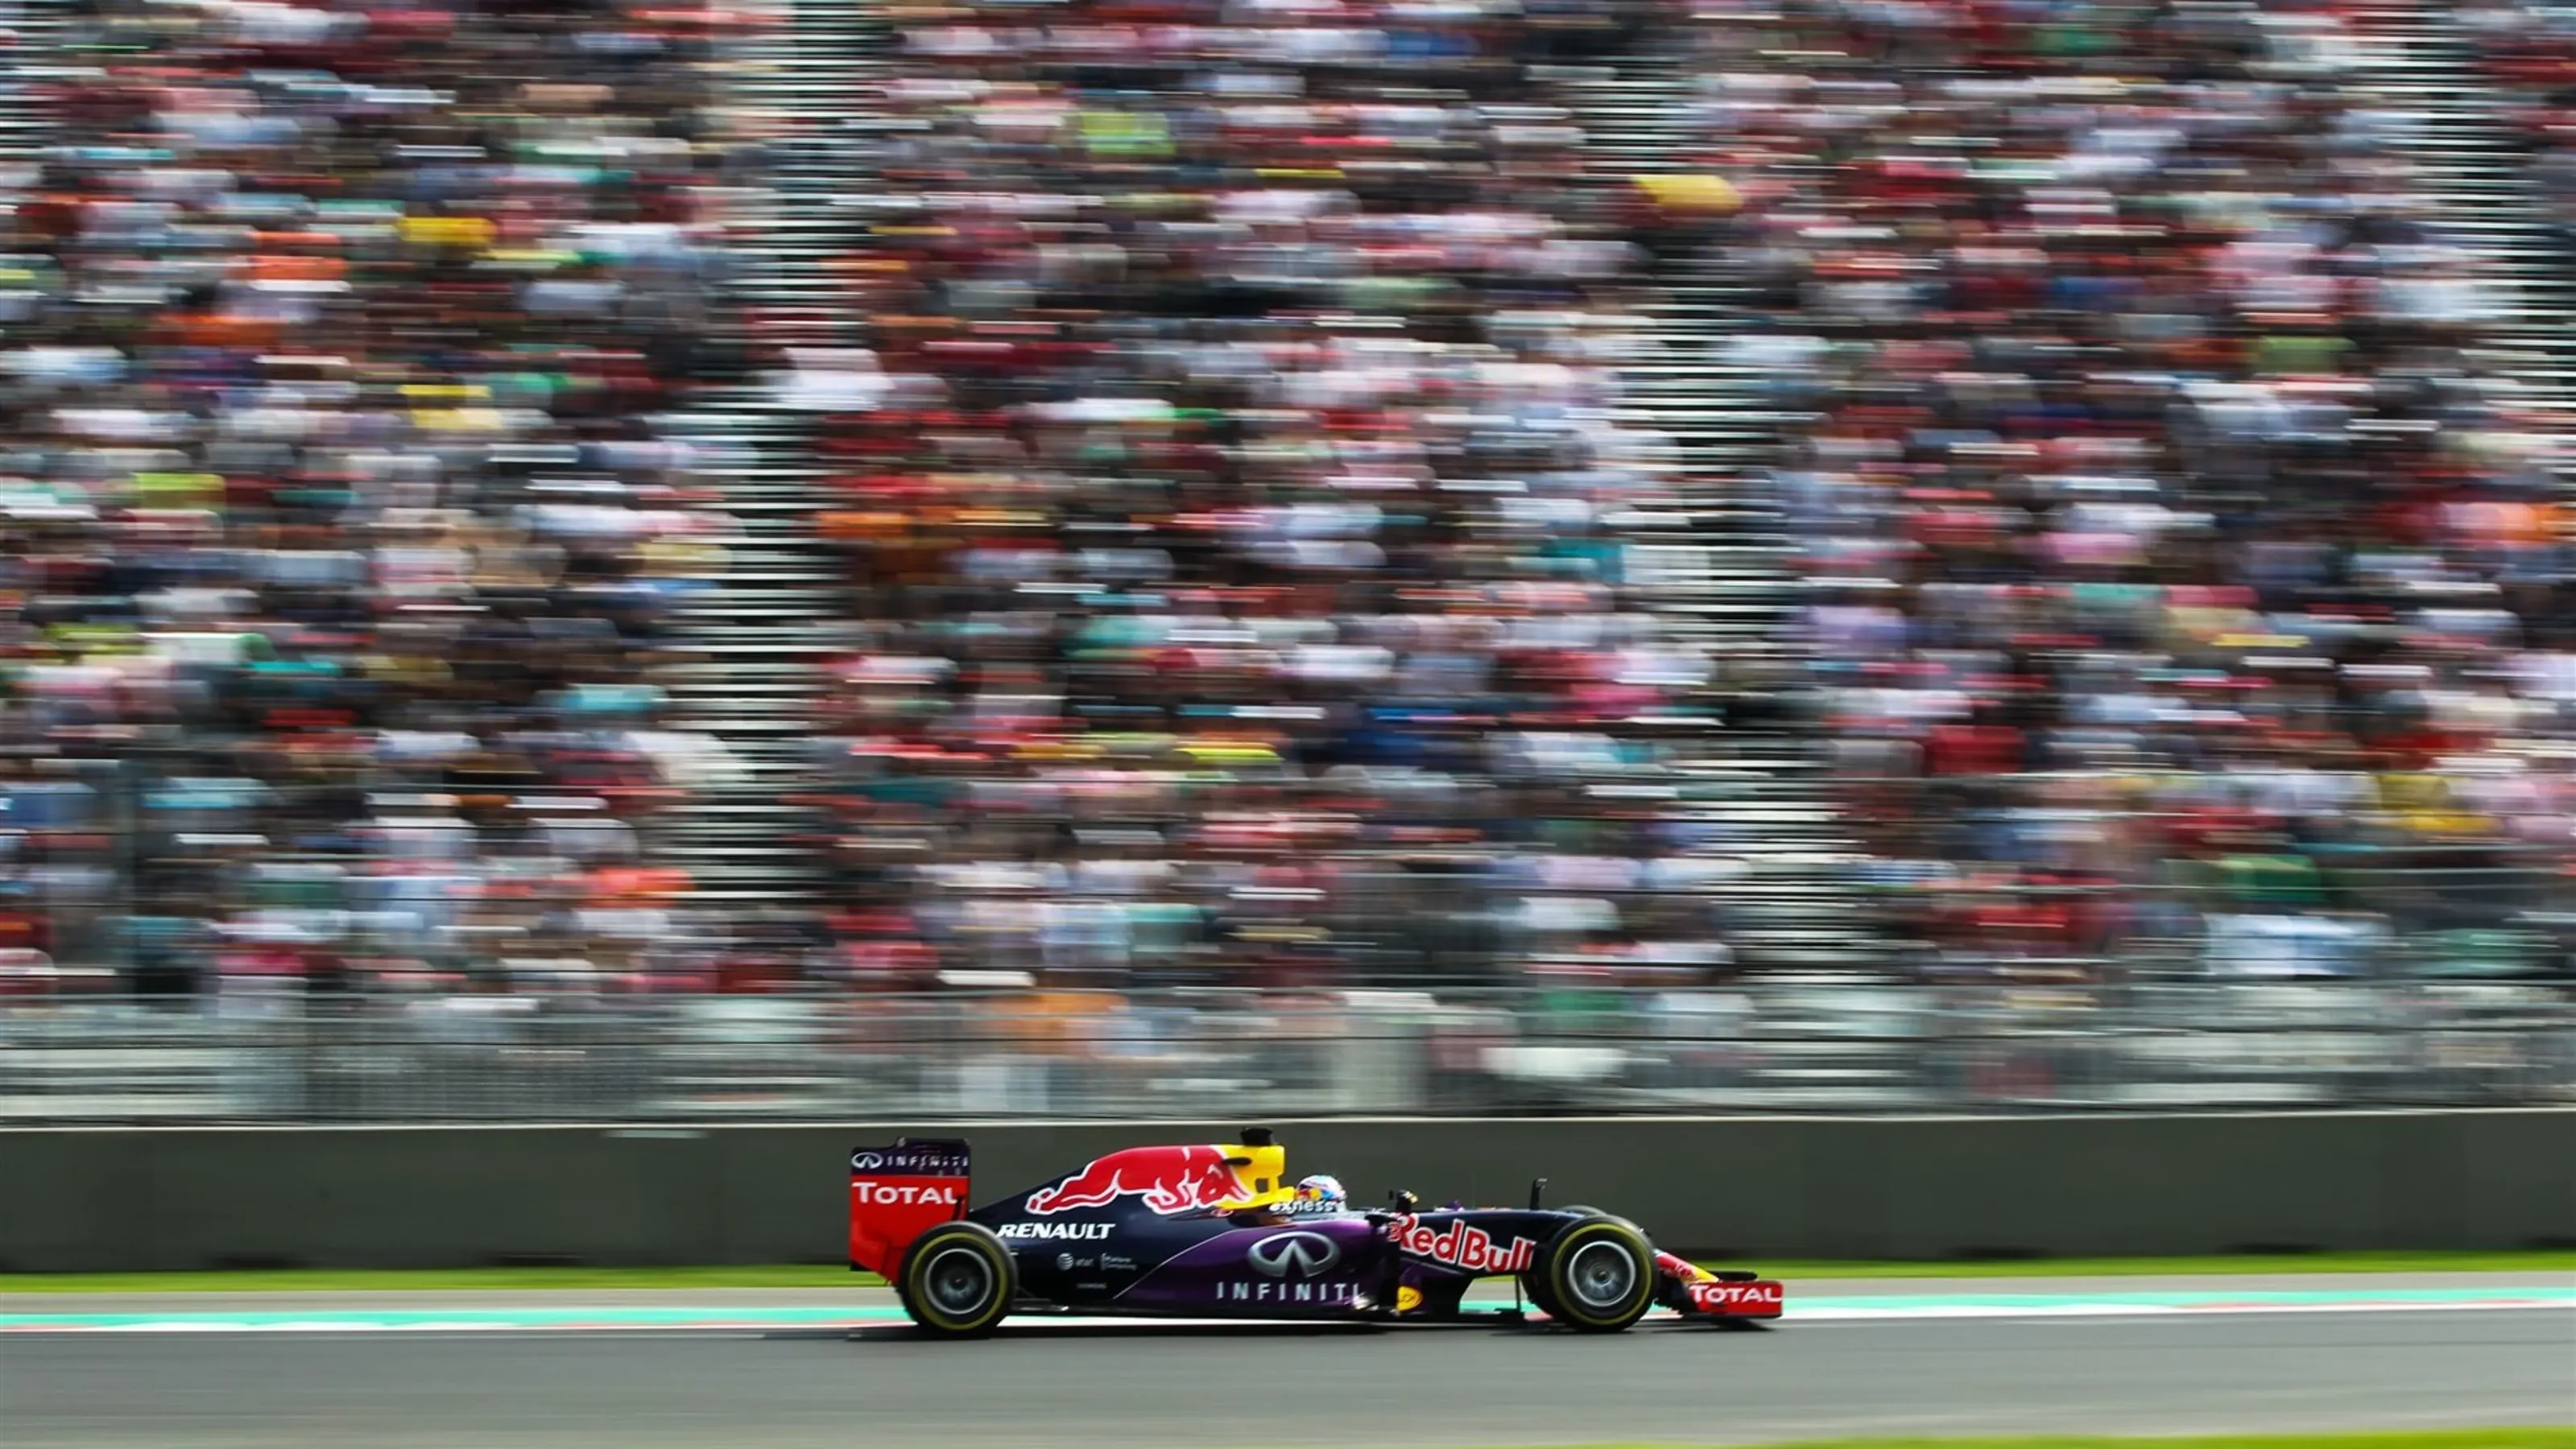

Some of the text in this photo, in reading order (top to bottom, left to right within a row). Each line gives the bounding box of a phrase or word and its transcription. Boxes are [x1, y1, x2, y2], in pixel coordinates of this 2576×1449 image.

[851, 1181, 958, 1204] TOTAL
[996, 1223, 1116, 1240] RENAULT
[1216, 1282, 1361, 1301] INFINITI
[1689, 1285, 1783, 1303] TOTAL
